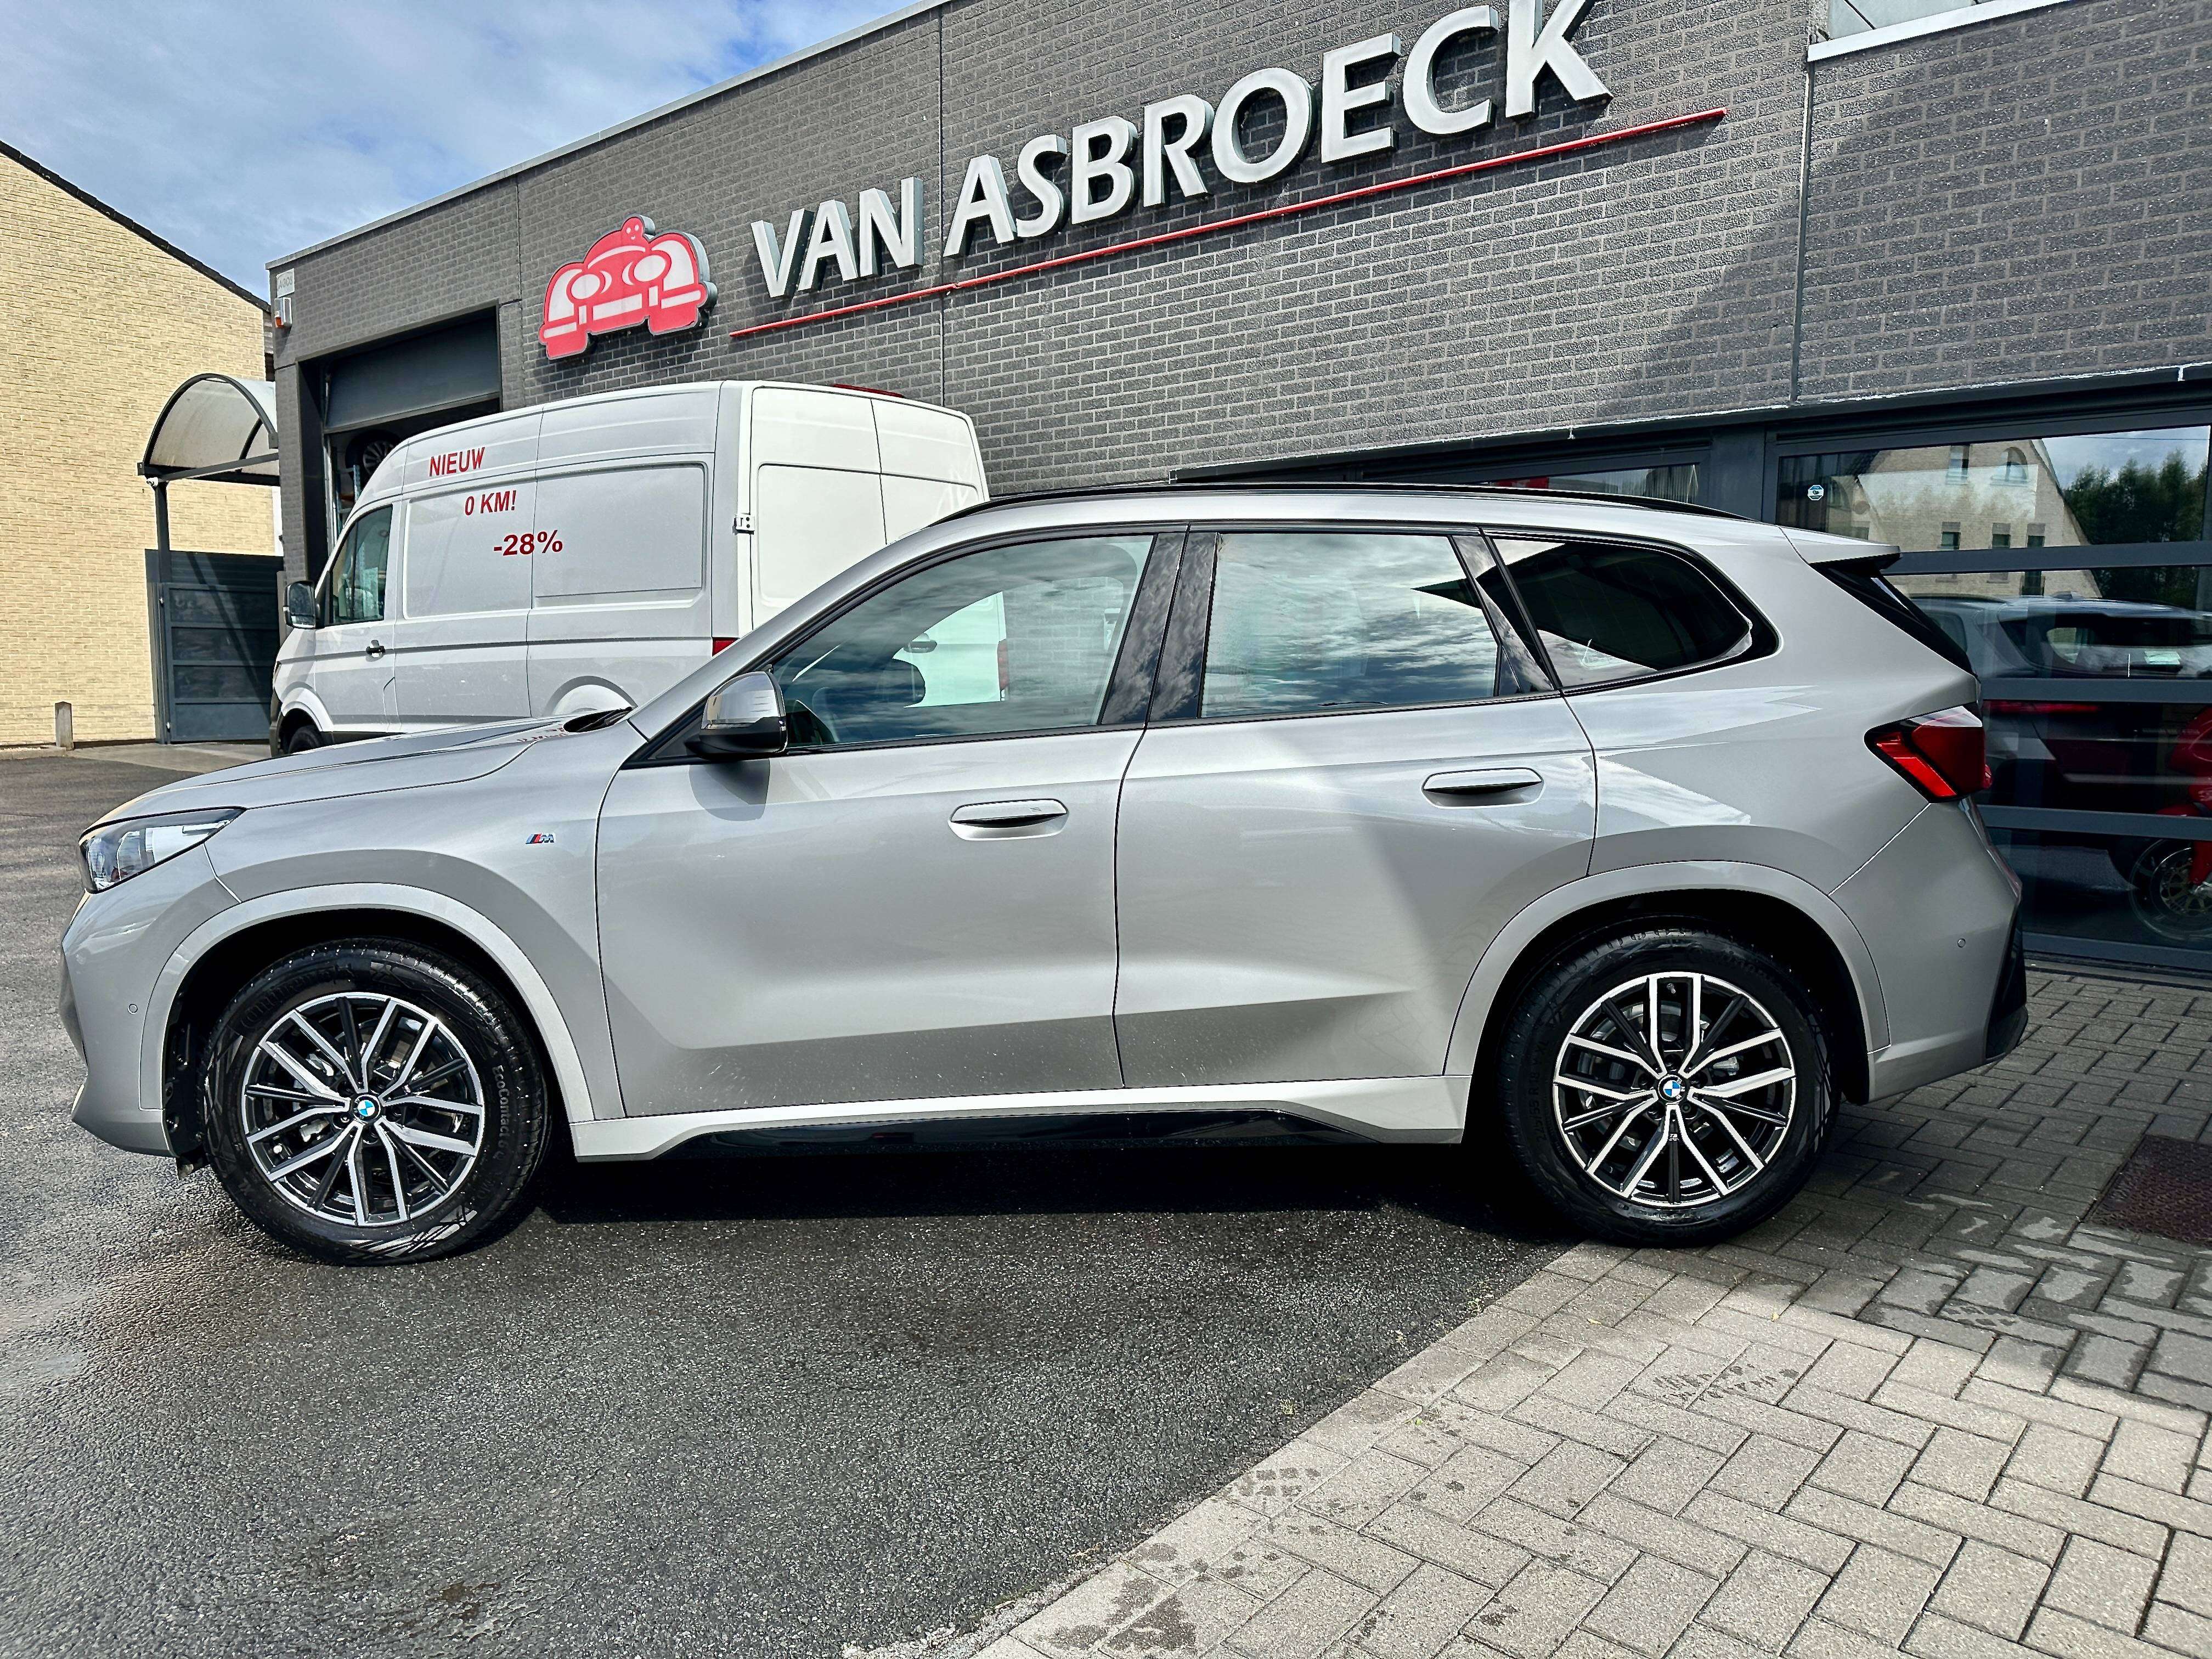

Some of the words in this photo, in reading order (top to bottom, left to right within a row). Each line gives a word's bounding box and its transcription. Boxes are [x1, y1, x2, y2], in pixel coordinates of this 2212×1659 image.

[751, 177, 919, 298] VAN
[943, 0, 1613, 258] ASBROECK
[429, 447, 485, 477] NIEUW
[465, 496, 474, 516] 0
[480, 490, 516, 514] KM!
[493, 529, 563, 556] -28%
[492, 1065, 509, 1137] EcoContact
